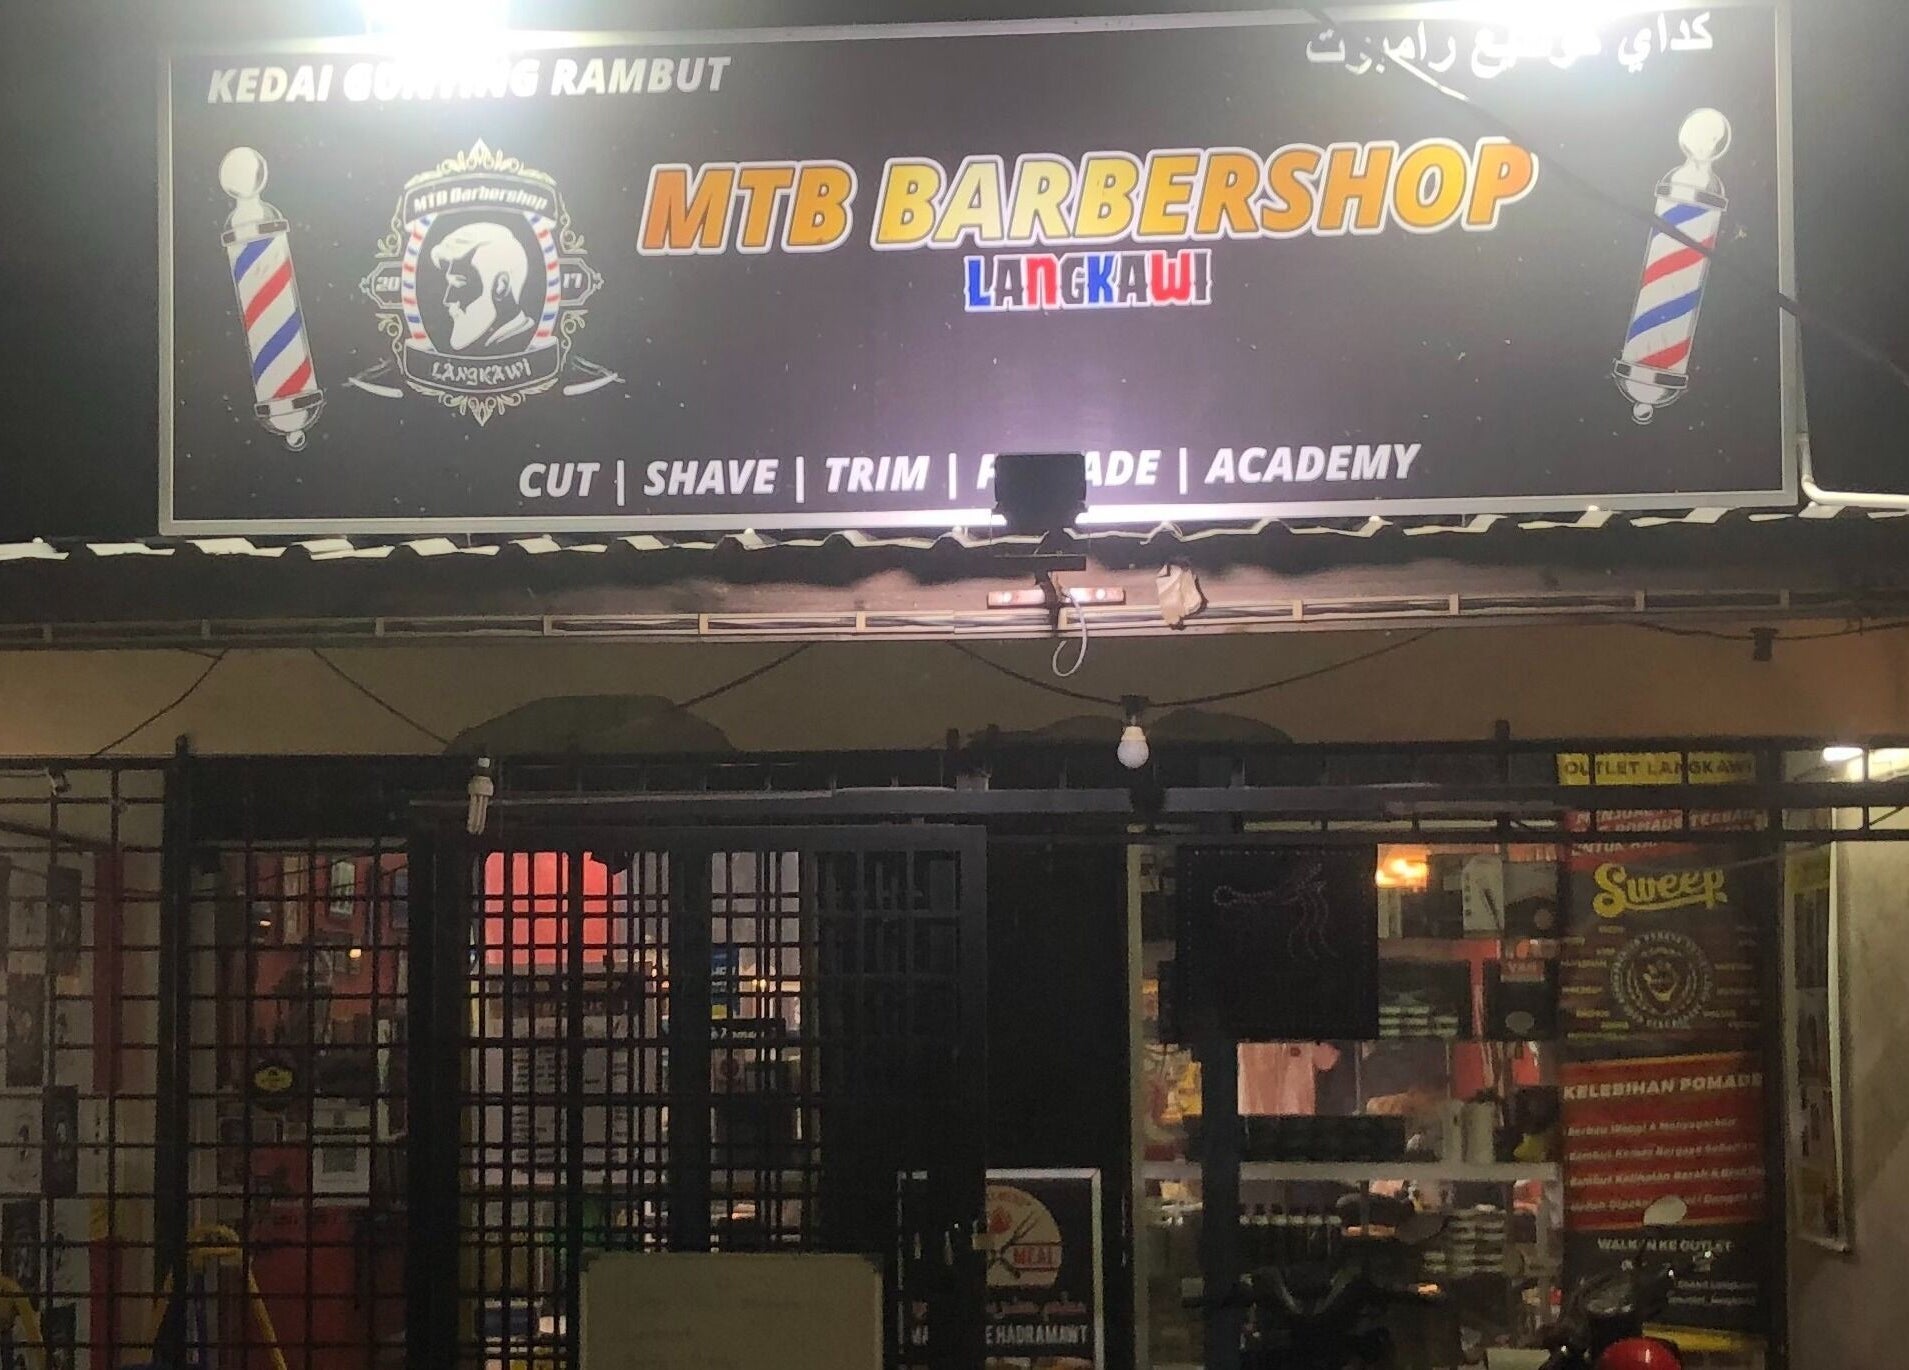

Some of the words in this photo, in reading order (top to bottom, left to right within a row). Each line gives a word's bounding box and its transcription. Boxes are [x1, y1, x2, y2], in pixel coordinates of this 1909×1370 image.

[207, 64, 334, 104] KEDAI
[551, 56, 732, 97] RAMBUT
[637, 159, 858, 256] MTB
[869, 136, 1539, 250] BARBERSHOP
[518, 461, 601, 499] CUT
[643, 458, 780, 497] SHAVE
[825, 456, 930, 494] TRIM
[1204, 443, 1422, 485] ACADEMY
[1592, 861, 1728, 918] Sweep
[1563, 1078, 1676, 1101] KELEBIHAN
